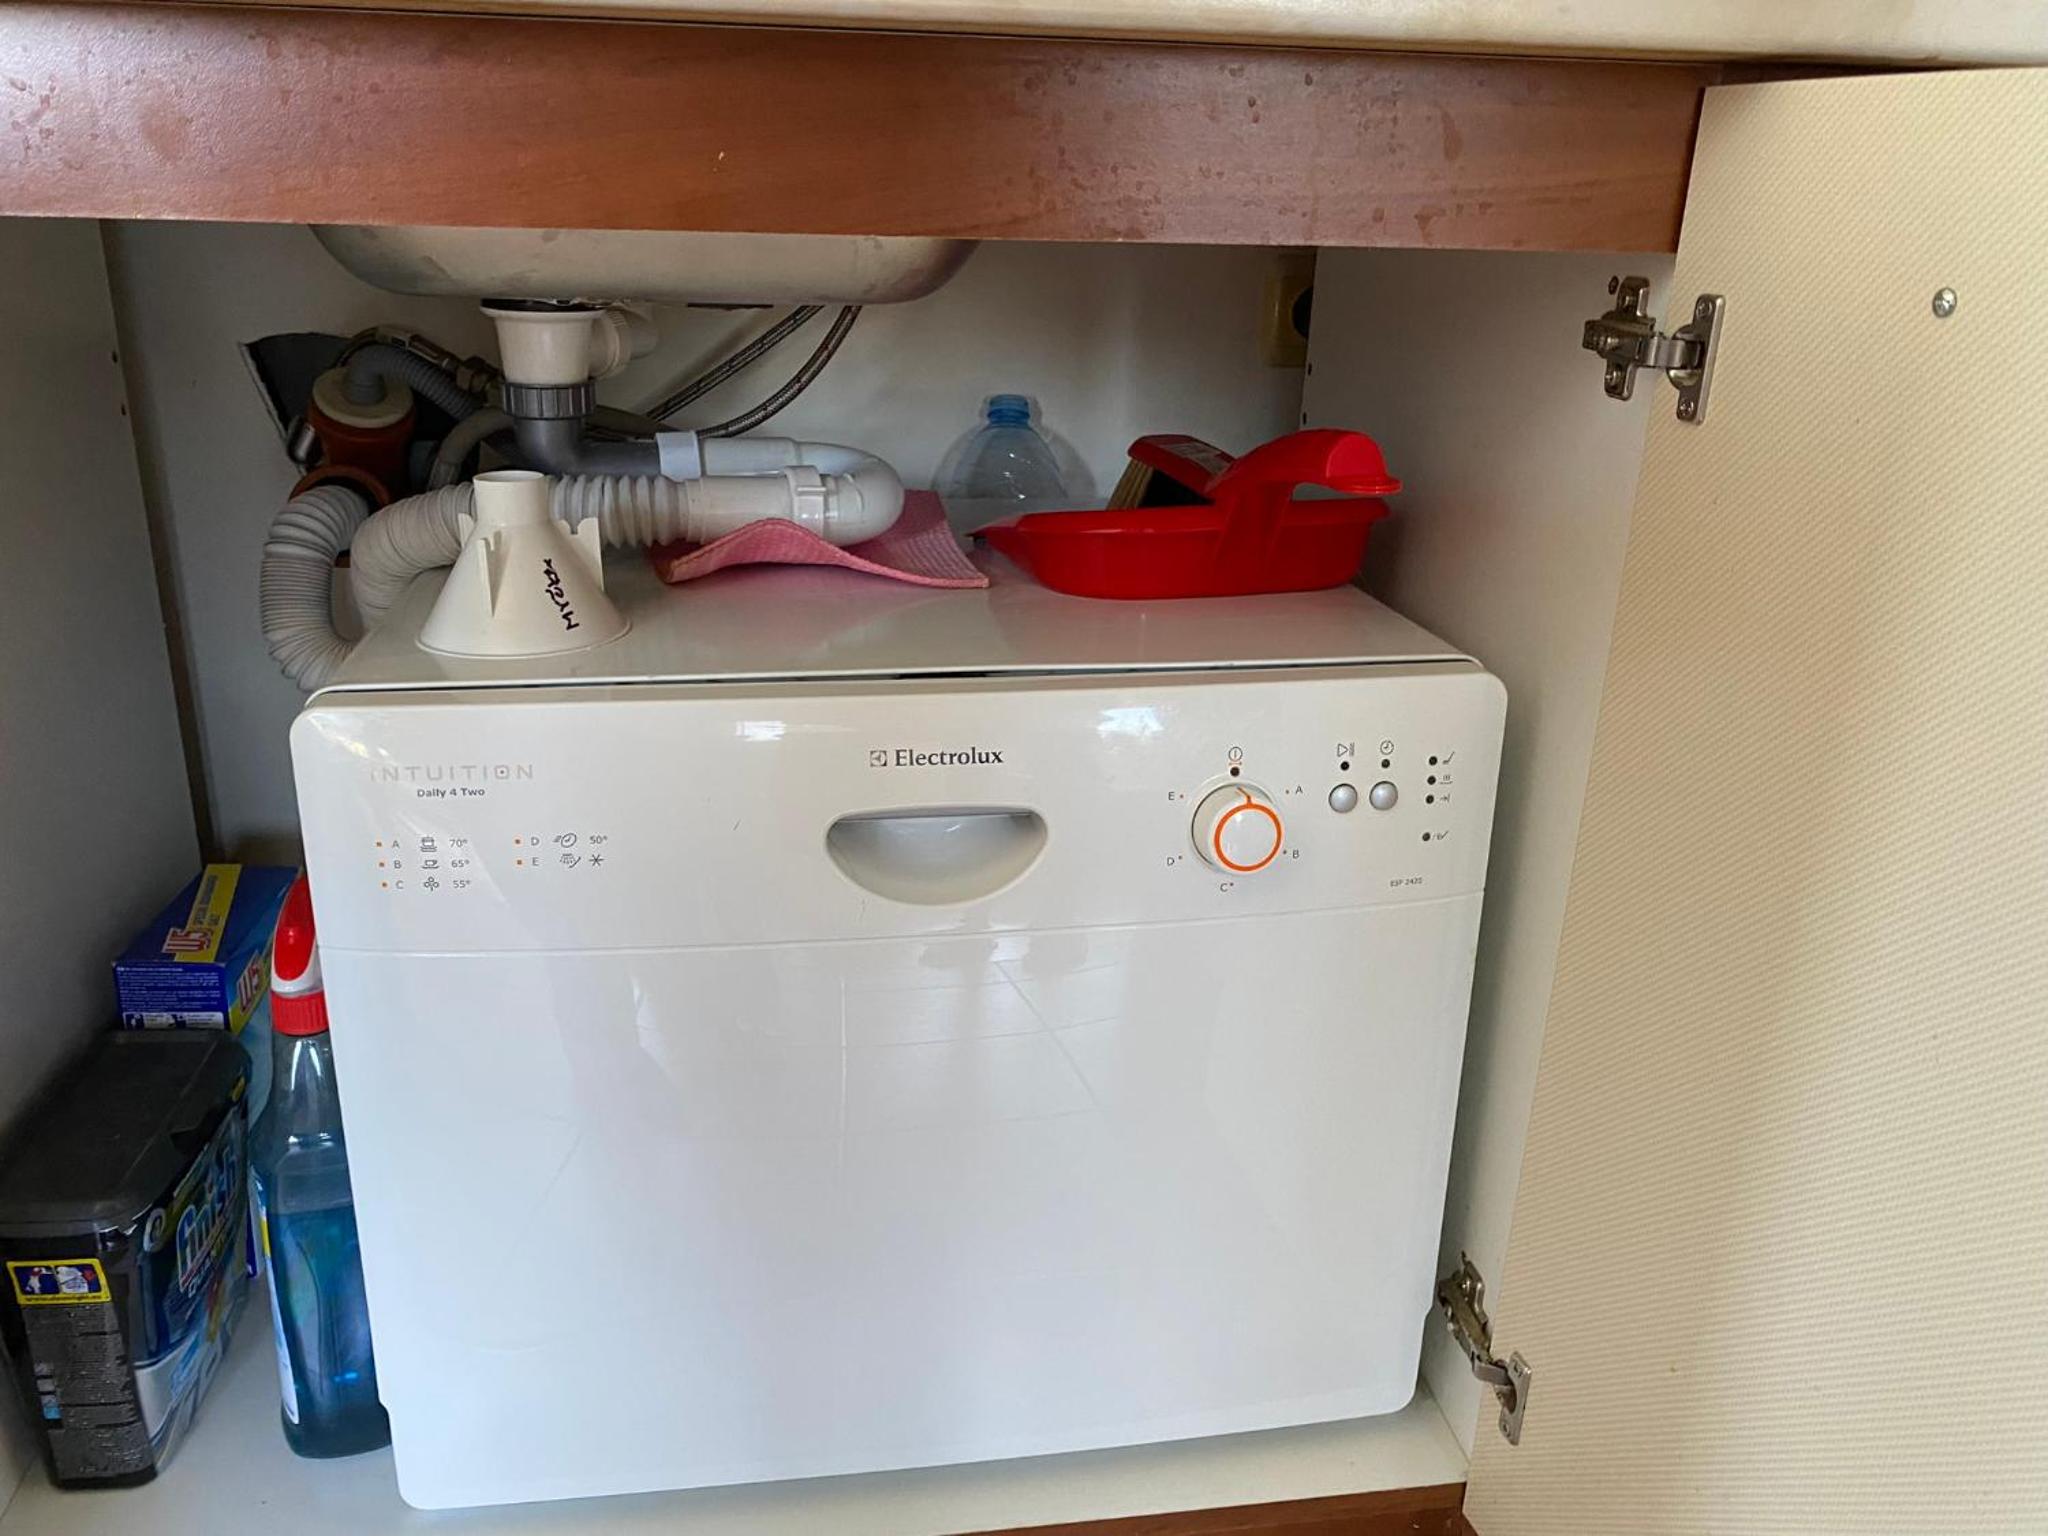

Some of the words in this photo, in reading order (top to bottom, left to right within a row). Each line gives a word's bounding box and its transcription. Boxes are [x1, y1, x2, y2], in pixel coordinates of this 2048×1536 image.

[895, 747, 1004, 767] Electrolux
[371, 764, 534, 781] INTUITION
[417, 788, 446, 799] Daily
[450, 788, 457, 797] 4
[460, 787, 486, 797] Two
[1295, 786, 1304, 795] A
[1168, 792, 1175, 801] E
[392, 840, 400, 849] A
[531, 837, 540, 846] D
[1293, 850, 1300, 859] B
[394, 860, 402, 869] B
[532, 857, 540, 867] E
[1167, 856, 1175, 866] D
[396, 880, 404, 889] C
[1220, 883, 1228, 893] C
